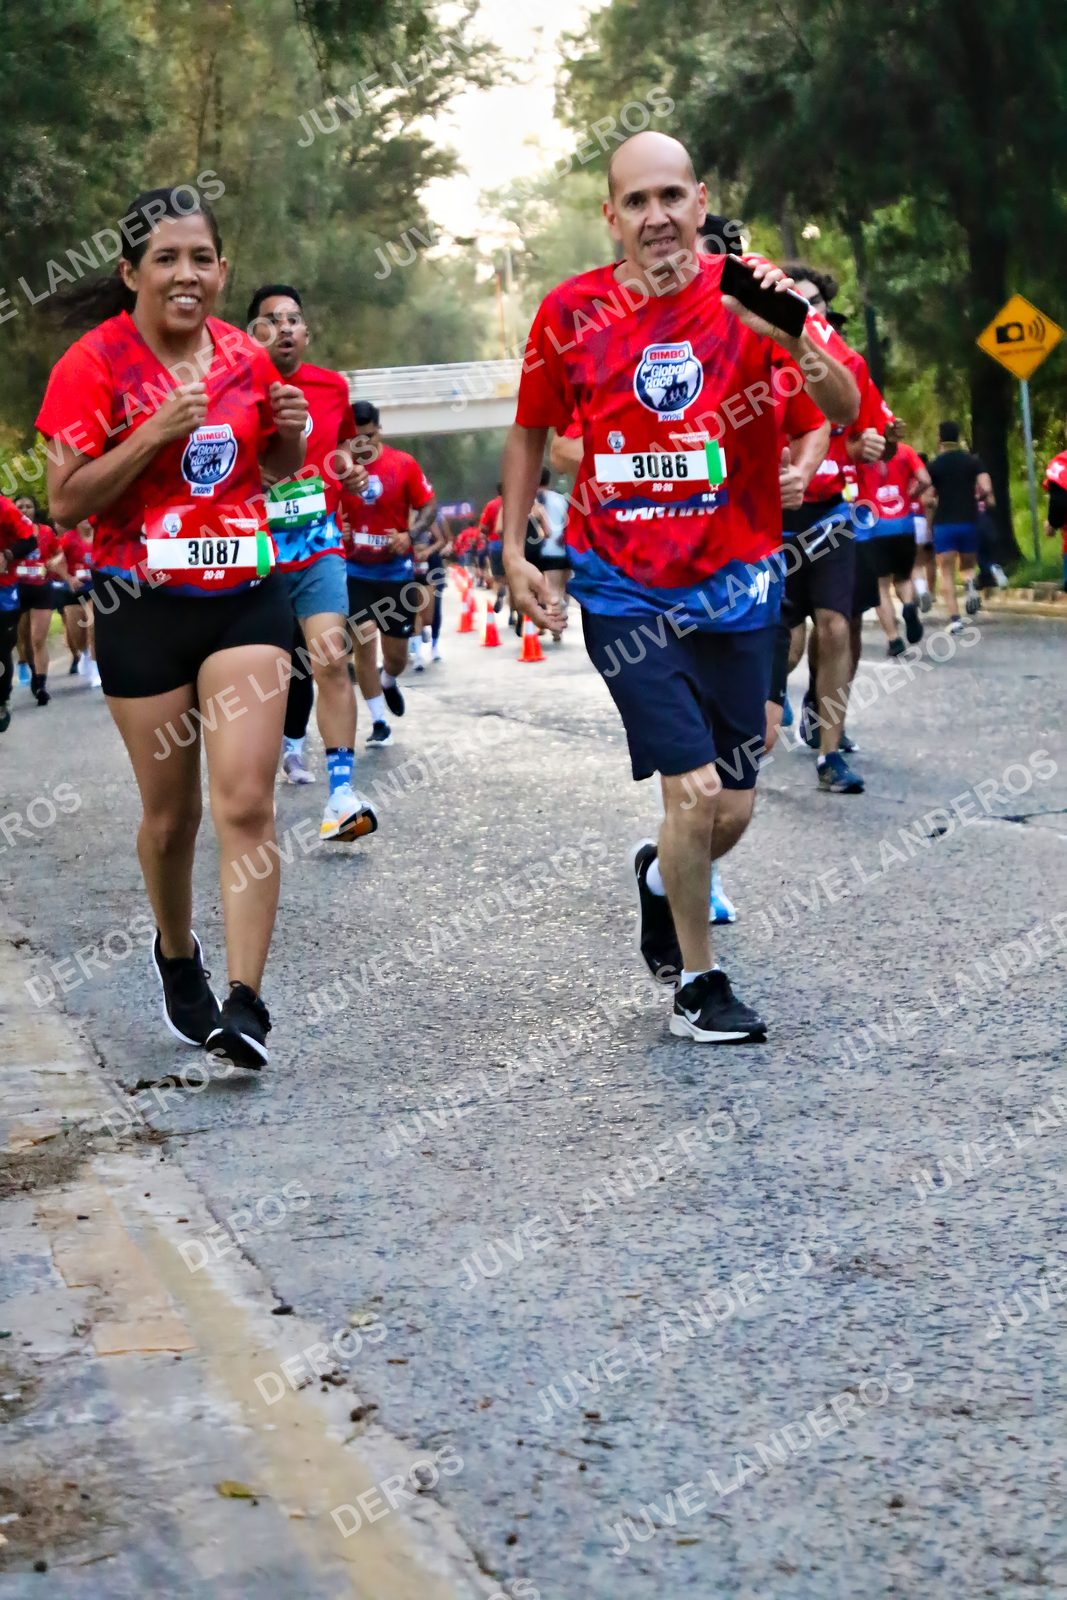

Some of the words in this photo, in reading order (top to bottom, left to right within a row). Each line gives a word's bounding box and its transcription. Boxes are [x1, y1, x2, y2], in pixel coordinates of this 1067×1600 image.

[649, 350, 686, 360] BIMBO
[651, 362, 687, 377] Global
[645, 375, 674, 388] Race
[196, 431, 228, 442] BIMBO
[198, 443, 226, 456] Global
[191, 454, 214, 467] Race
[632, 454, 689, 479] 3086
[193, 486, 212, 494] 2026
[284, 500, 300, 515] 45
[188, 539, 240, 566] 3087
